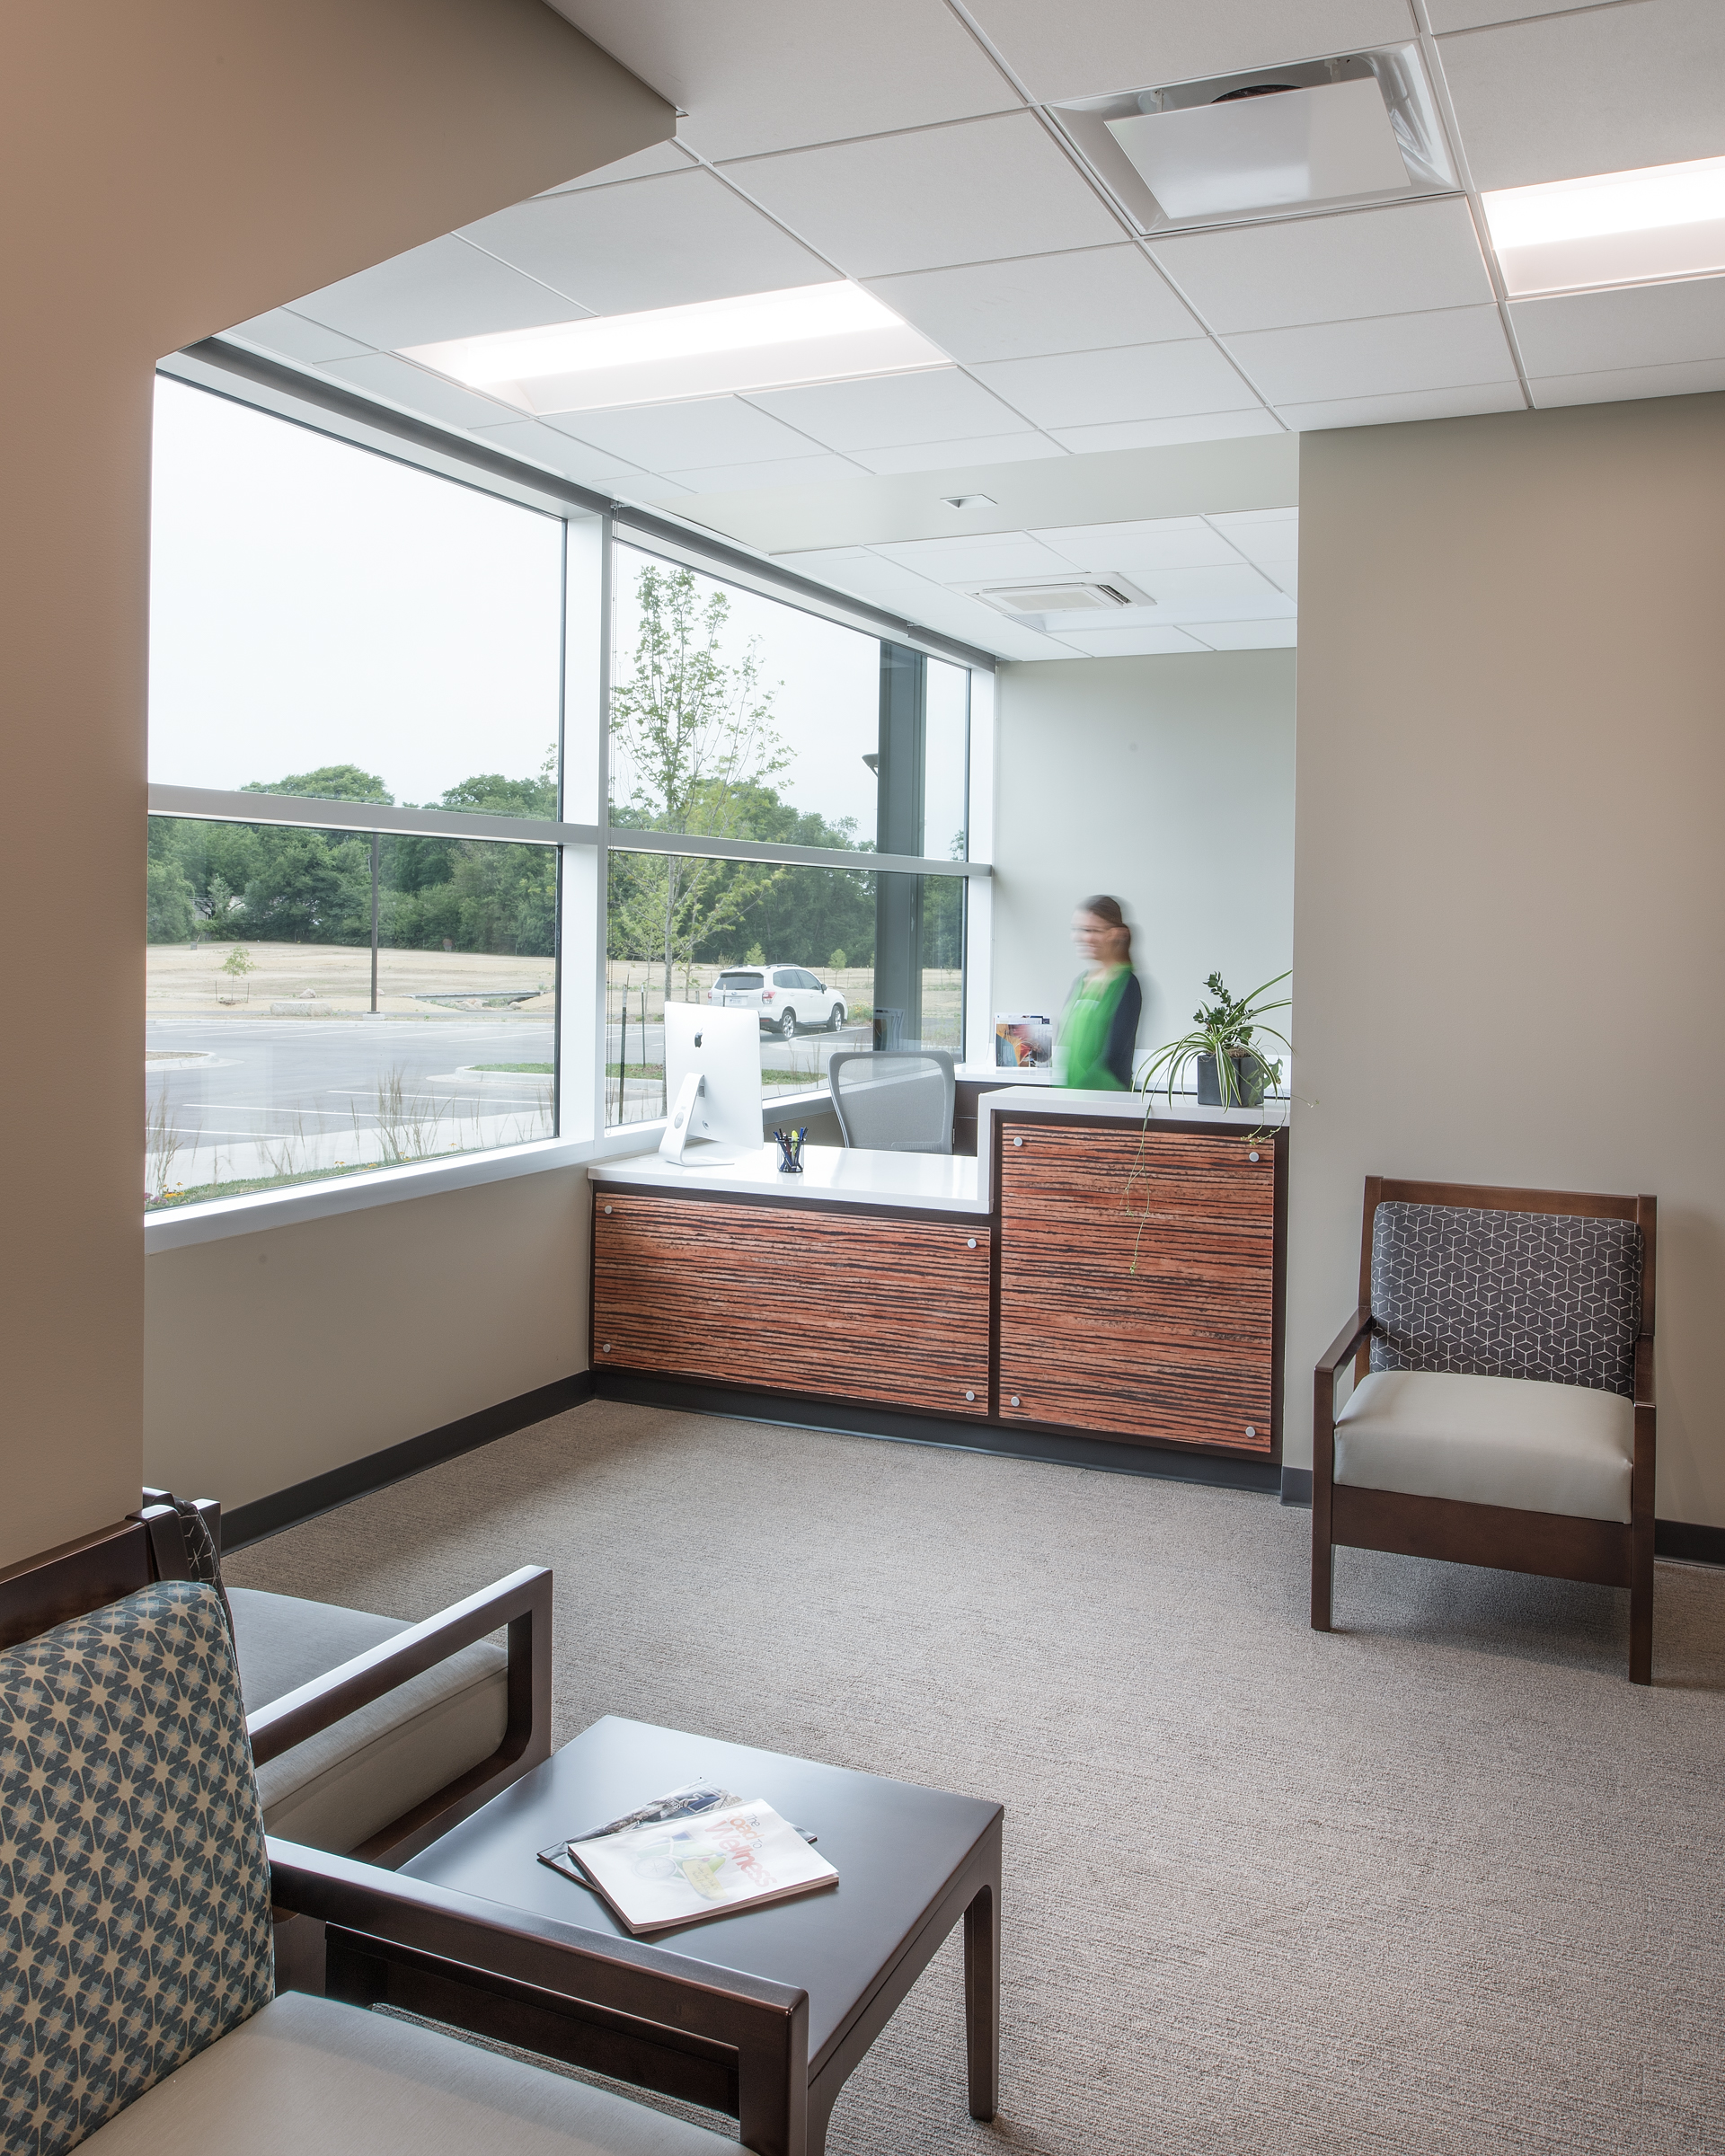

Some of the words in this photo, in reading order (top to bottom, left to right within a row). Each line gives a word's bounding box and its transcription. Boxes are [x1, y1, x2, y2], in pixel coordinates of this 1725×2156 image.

[721, 1810, 765, 1841] Road
[745, 1813, 760, 1827] The
[704, 1819, 778, 1887] Wellness
